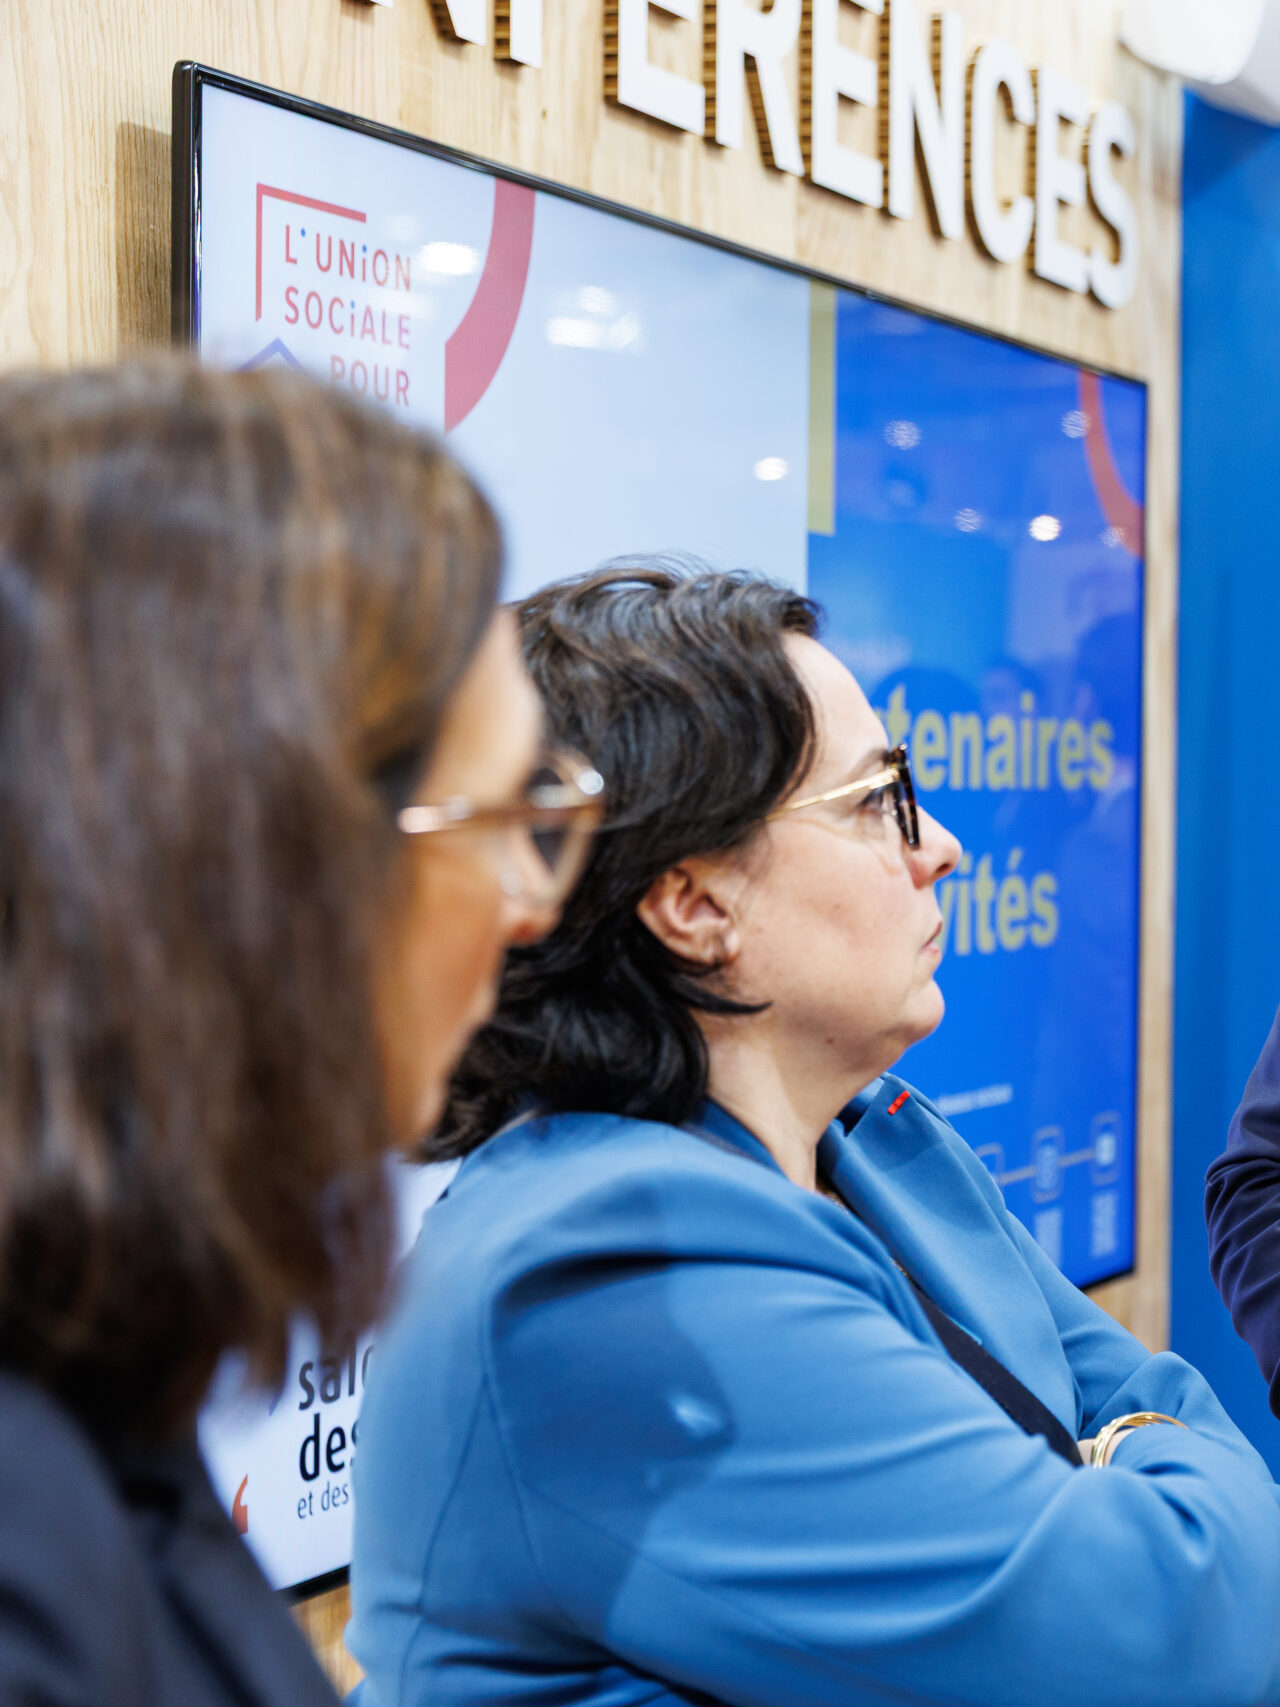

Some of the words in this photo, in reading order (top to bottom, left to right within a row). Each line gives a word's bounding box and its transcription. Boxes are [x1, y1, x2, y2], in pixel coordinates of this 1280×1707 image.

[330, 354, 410, 408] POUR
[873, 683, 1115, 792] tenaires
[297, 1490, 314, 1520] et
[321, 1480, 350, 1512] des
